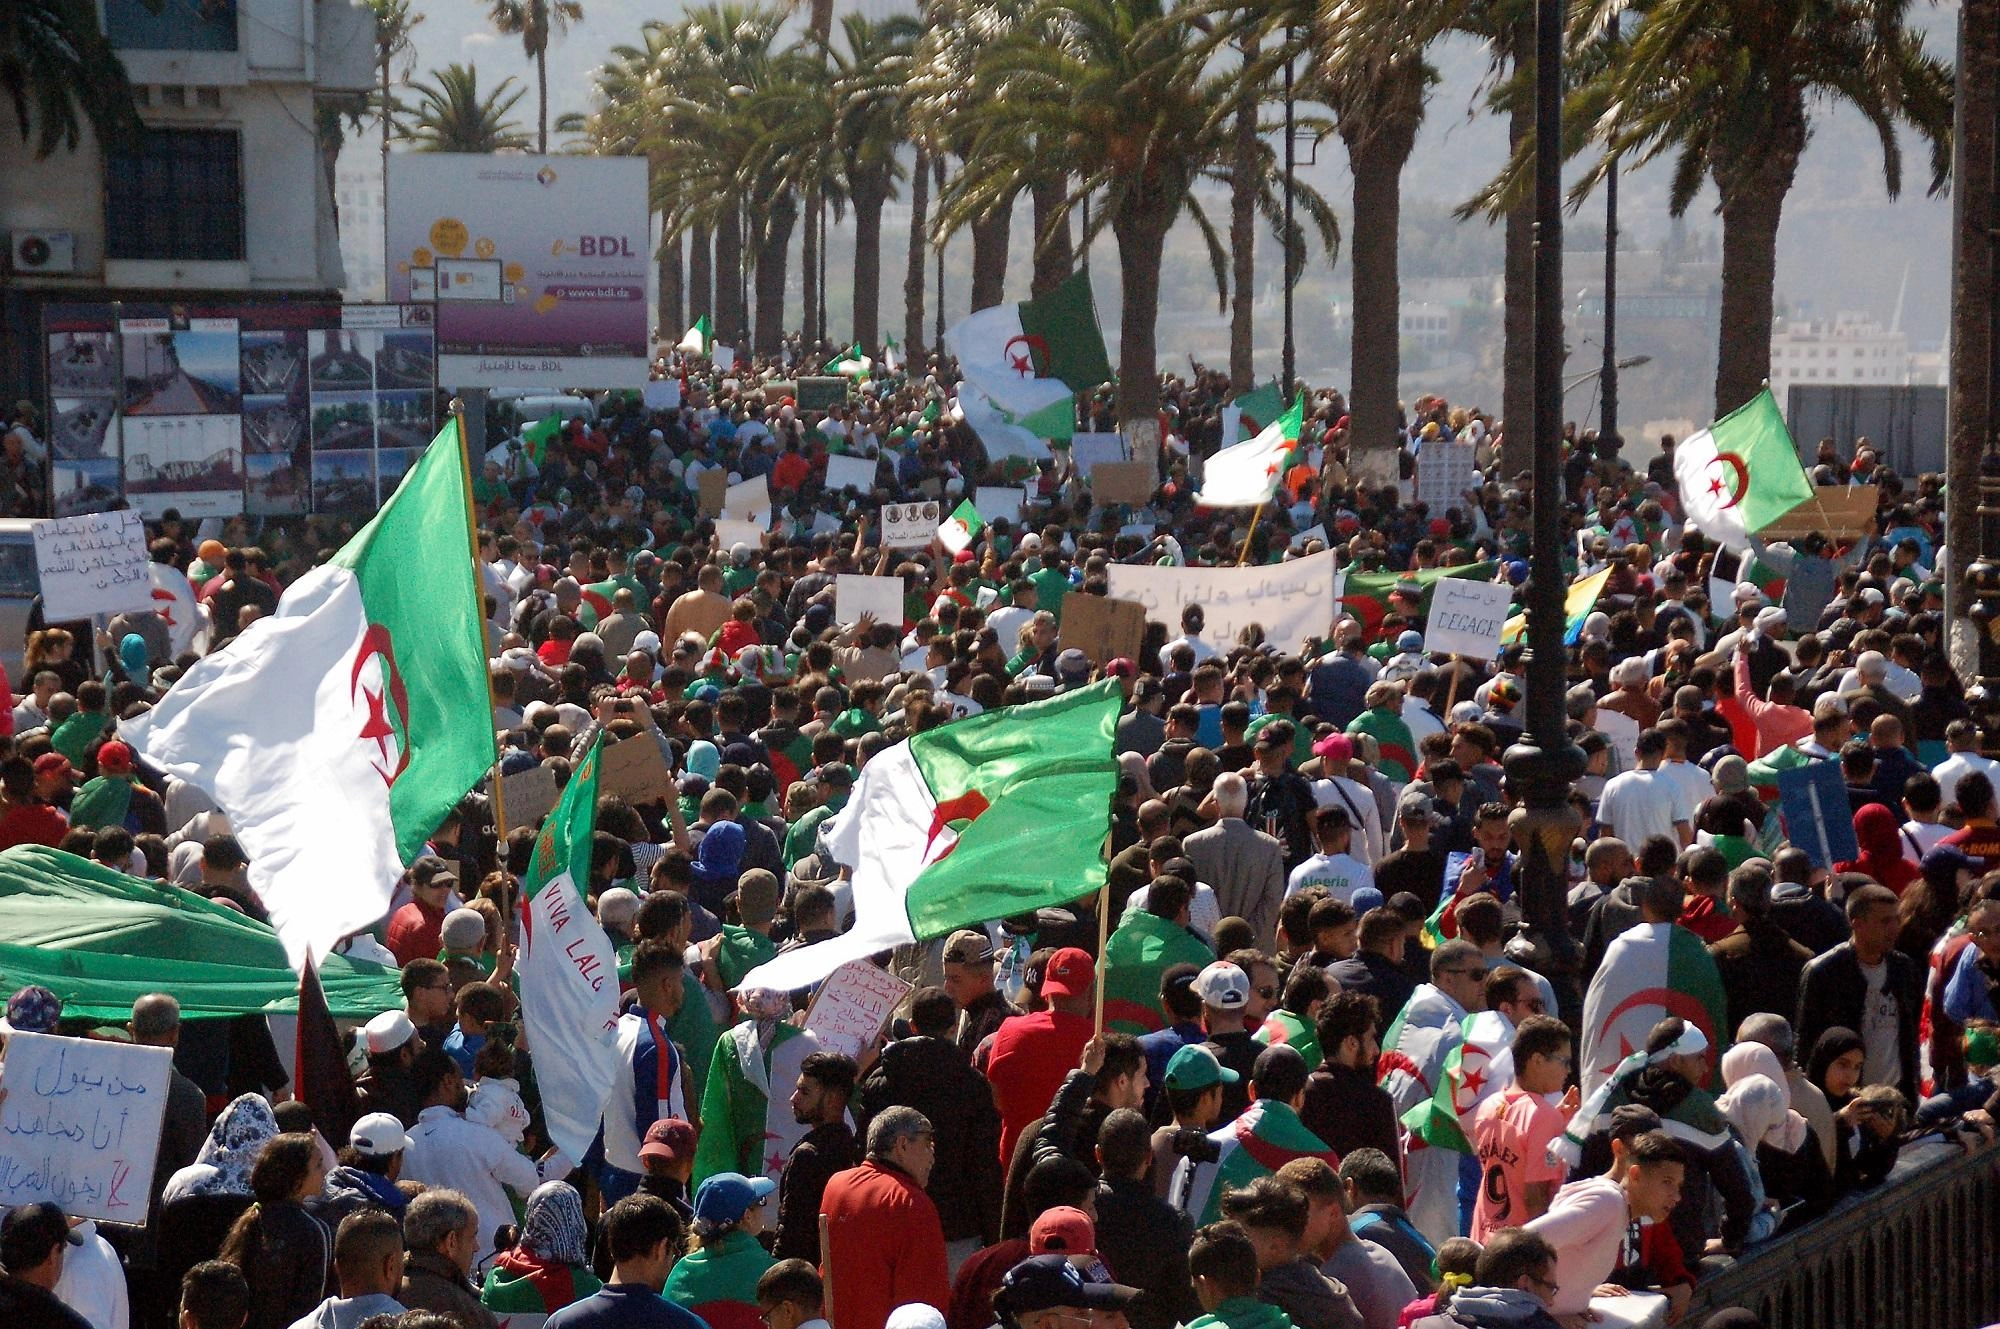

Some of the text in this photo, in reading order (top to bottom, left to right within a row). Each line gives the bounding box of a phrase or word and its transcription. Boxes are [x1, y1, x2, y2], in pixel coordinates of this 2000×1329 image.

[568, 287, 630, 298] www.bdl.dz
[544, 881, 571, 935] VIVA
[107, 1075, 147, 1097] من
[4, 1101, 129, 1151] أنا مجاهد
[1484, 1162, 1512, 1222] 9
